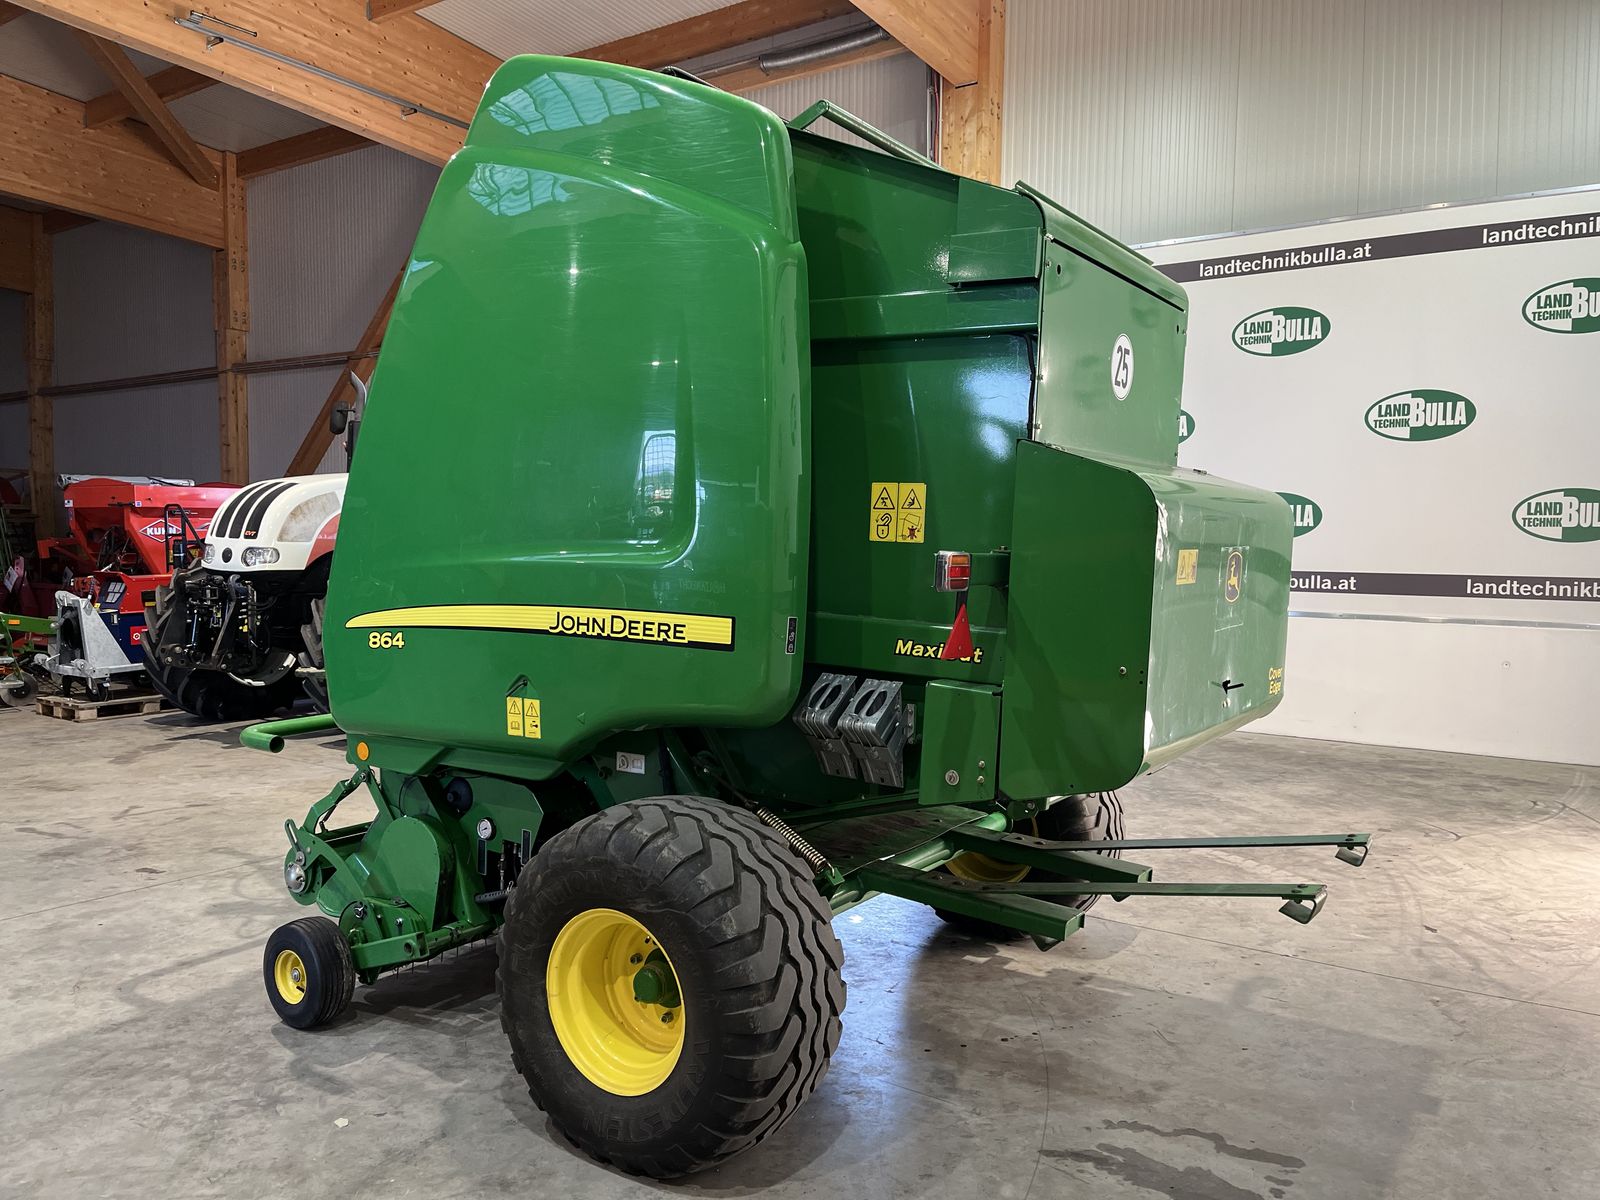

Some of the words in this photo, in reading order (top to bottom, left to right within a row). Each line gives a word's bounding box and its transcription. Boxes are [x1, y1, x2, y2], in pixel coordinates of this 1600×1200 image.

[1199, 243, 1372, 278] landtechnikbulla.at
[1536, 293, 1573, 310] LAND
[1531, 308, 1573, 321] TECHNIK
[1243, 320, 1273, 336] LAND
[1271, 314, 1323, 344] BULLA
[1239, 334, 1273, 346] TECHNIK
[1114, 344, 1131, 389] 25
[1377, 403, 1411, 418] LAND
[1409, 397, 1467, 428] BULLA
[1373, 418, 1411, 429] TECHNIK
[1526, 501, 1563, 516] LAND
[1521, 517, 1563, 528] TECHNIK
[549, 611, 607, 635] JOHN
[609, 614, 687, 641] DEERE
[367, 631, 405, 649] 864
